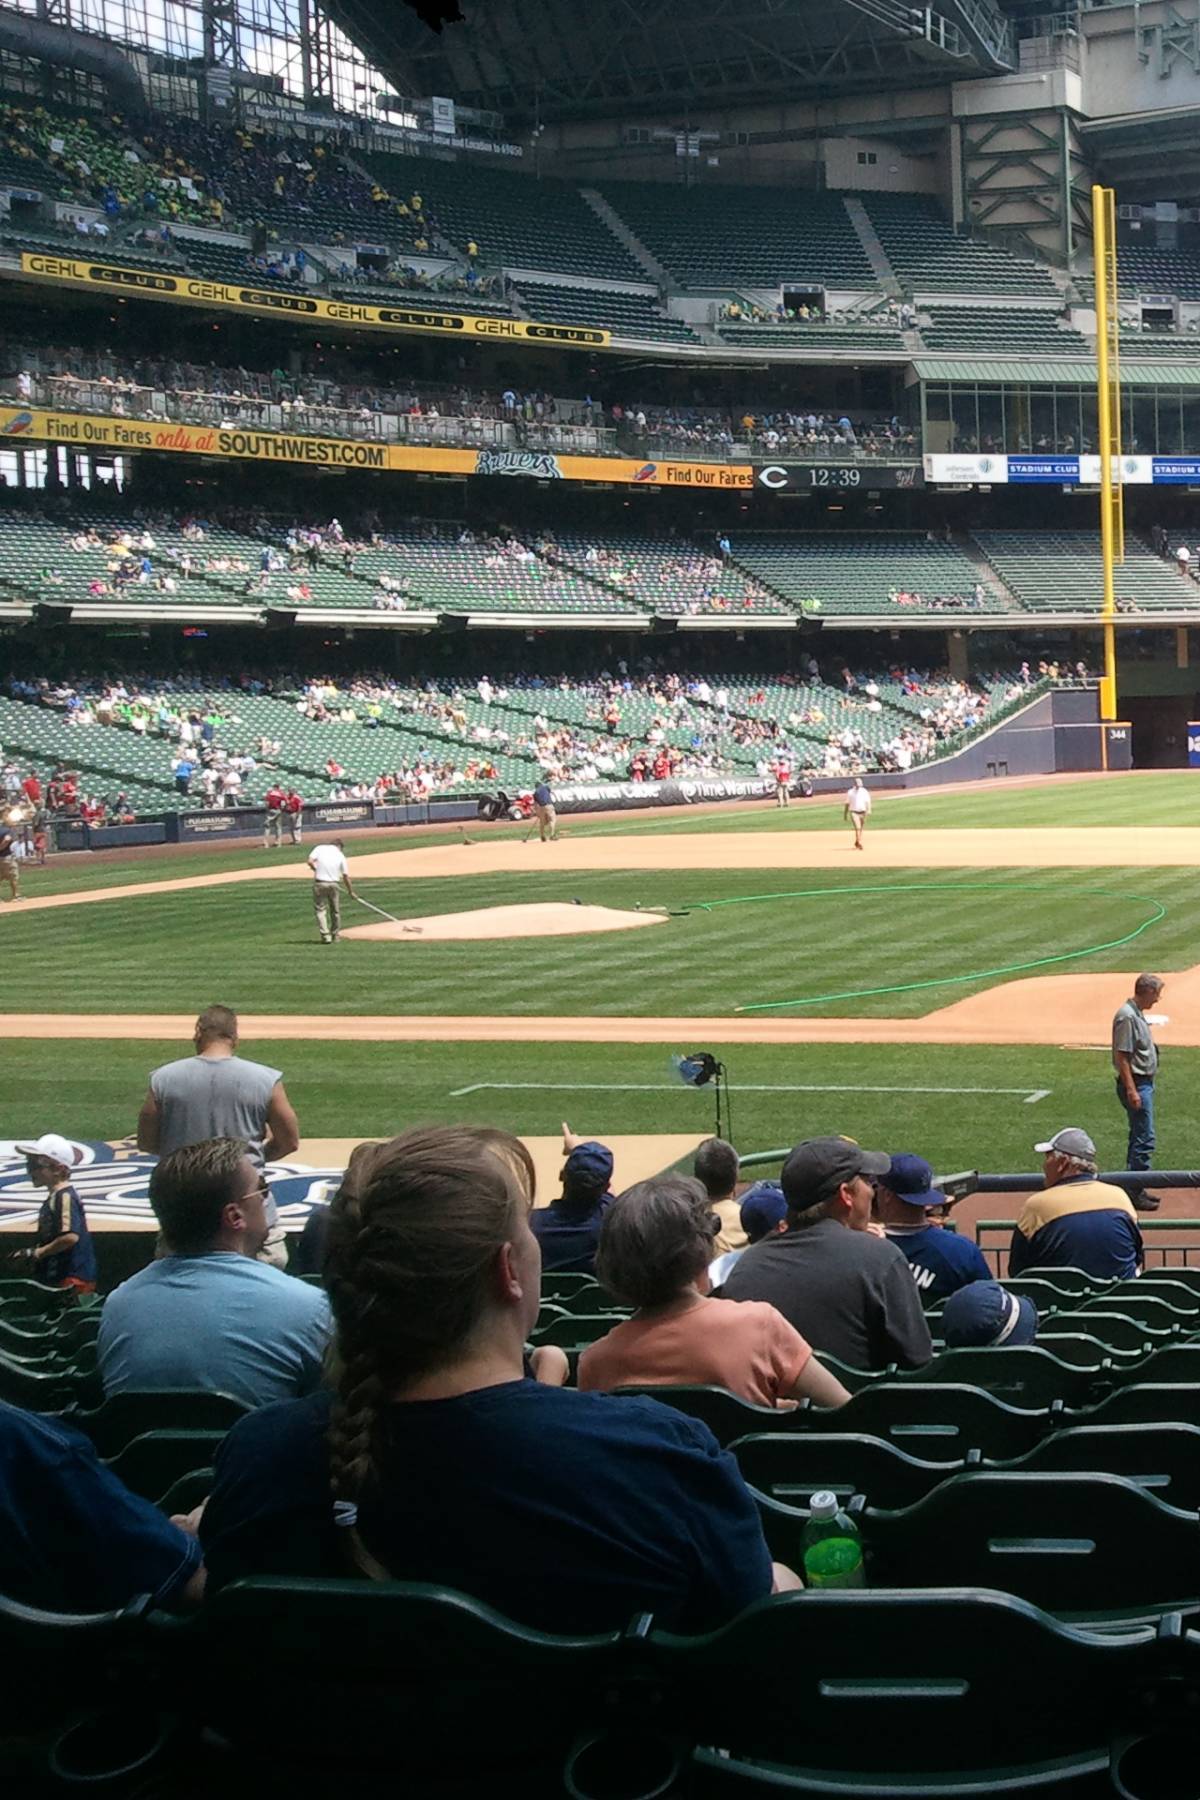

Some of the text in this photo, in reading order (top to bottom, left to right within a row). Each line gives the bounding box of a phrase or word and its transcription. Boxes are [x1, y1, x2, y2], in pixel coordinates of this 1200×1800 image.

[30, 257, 594, 340] GEHL CLUB GEHL CLUB GEHL CLUB GEHL CLUB
[47, 418, 384, 466] Find Our Fares only at SOUTHWEST.COM
[477, 450, 560, 479] Brewers
[1010, 465, 1078, 473] STADIUM CLUB
[667, 468, 754, 485] Find Our Fares
[809, 469, 861, 486] 12:39
[1110, 729, 1126, 739] 344
[575, 783, 661, 800] Warner Cable
[695, 780, 764, 797] Time Warner
